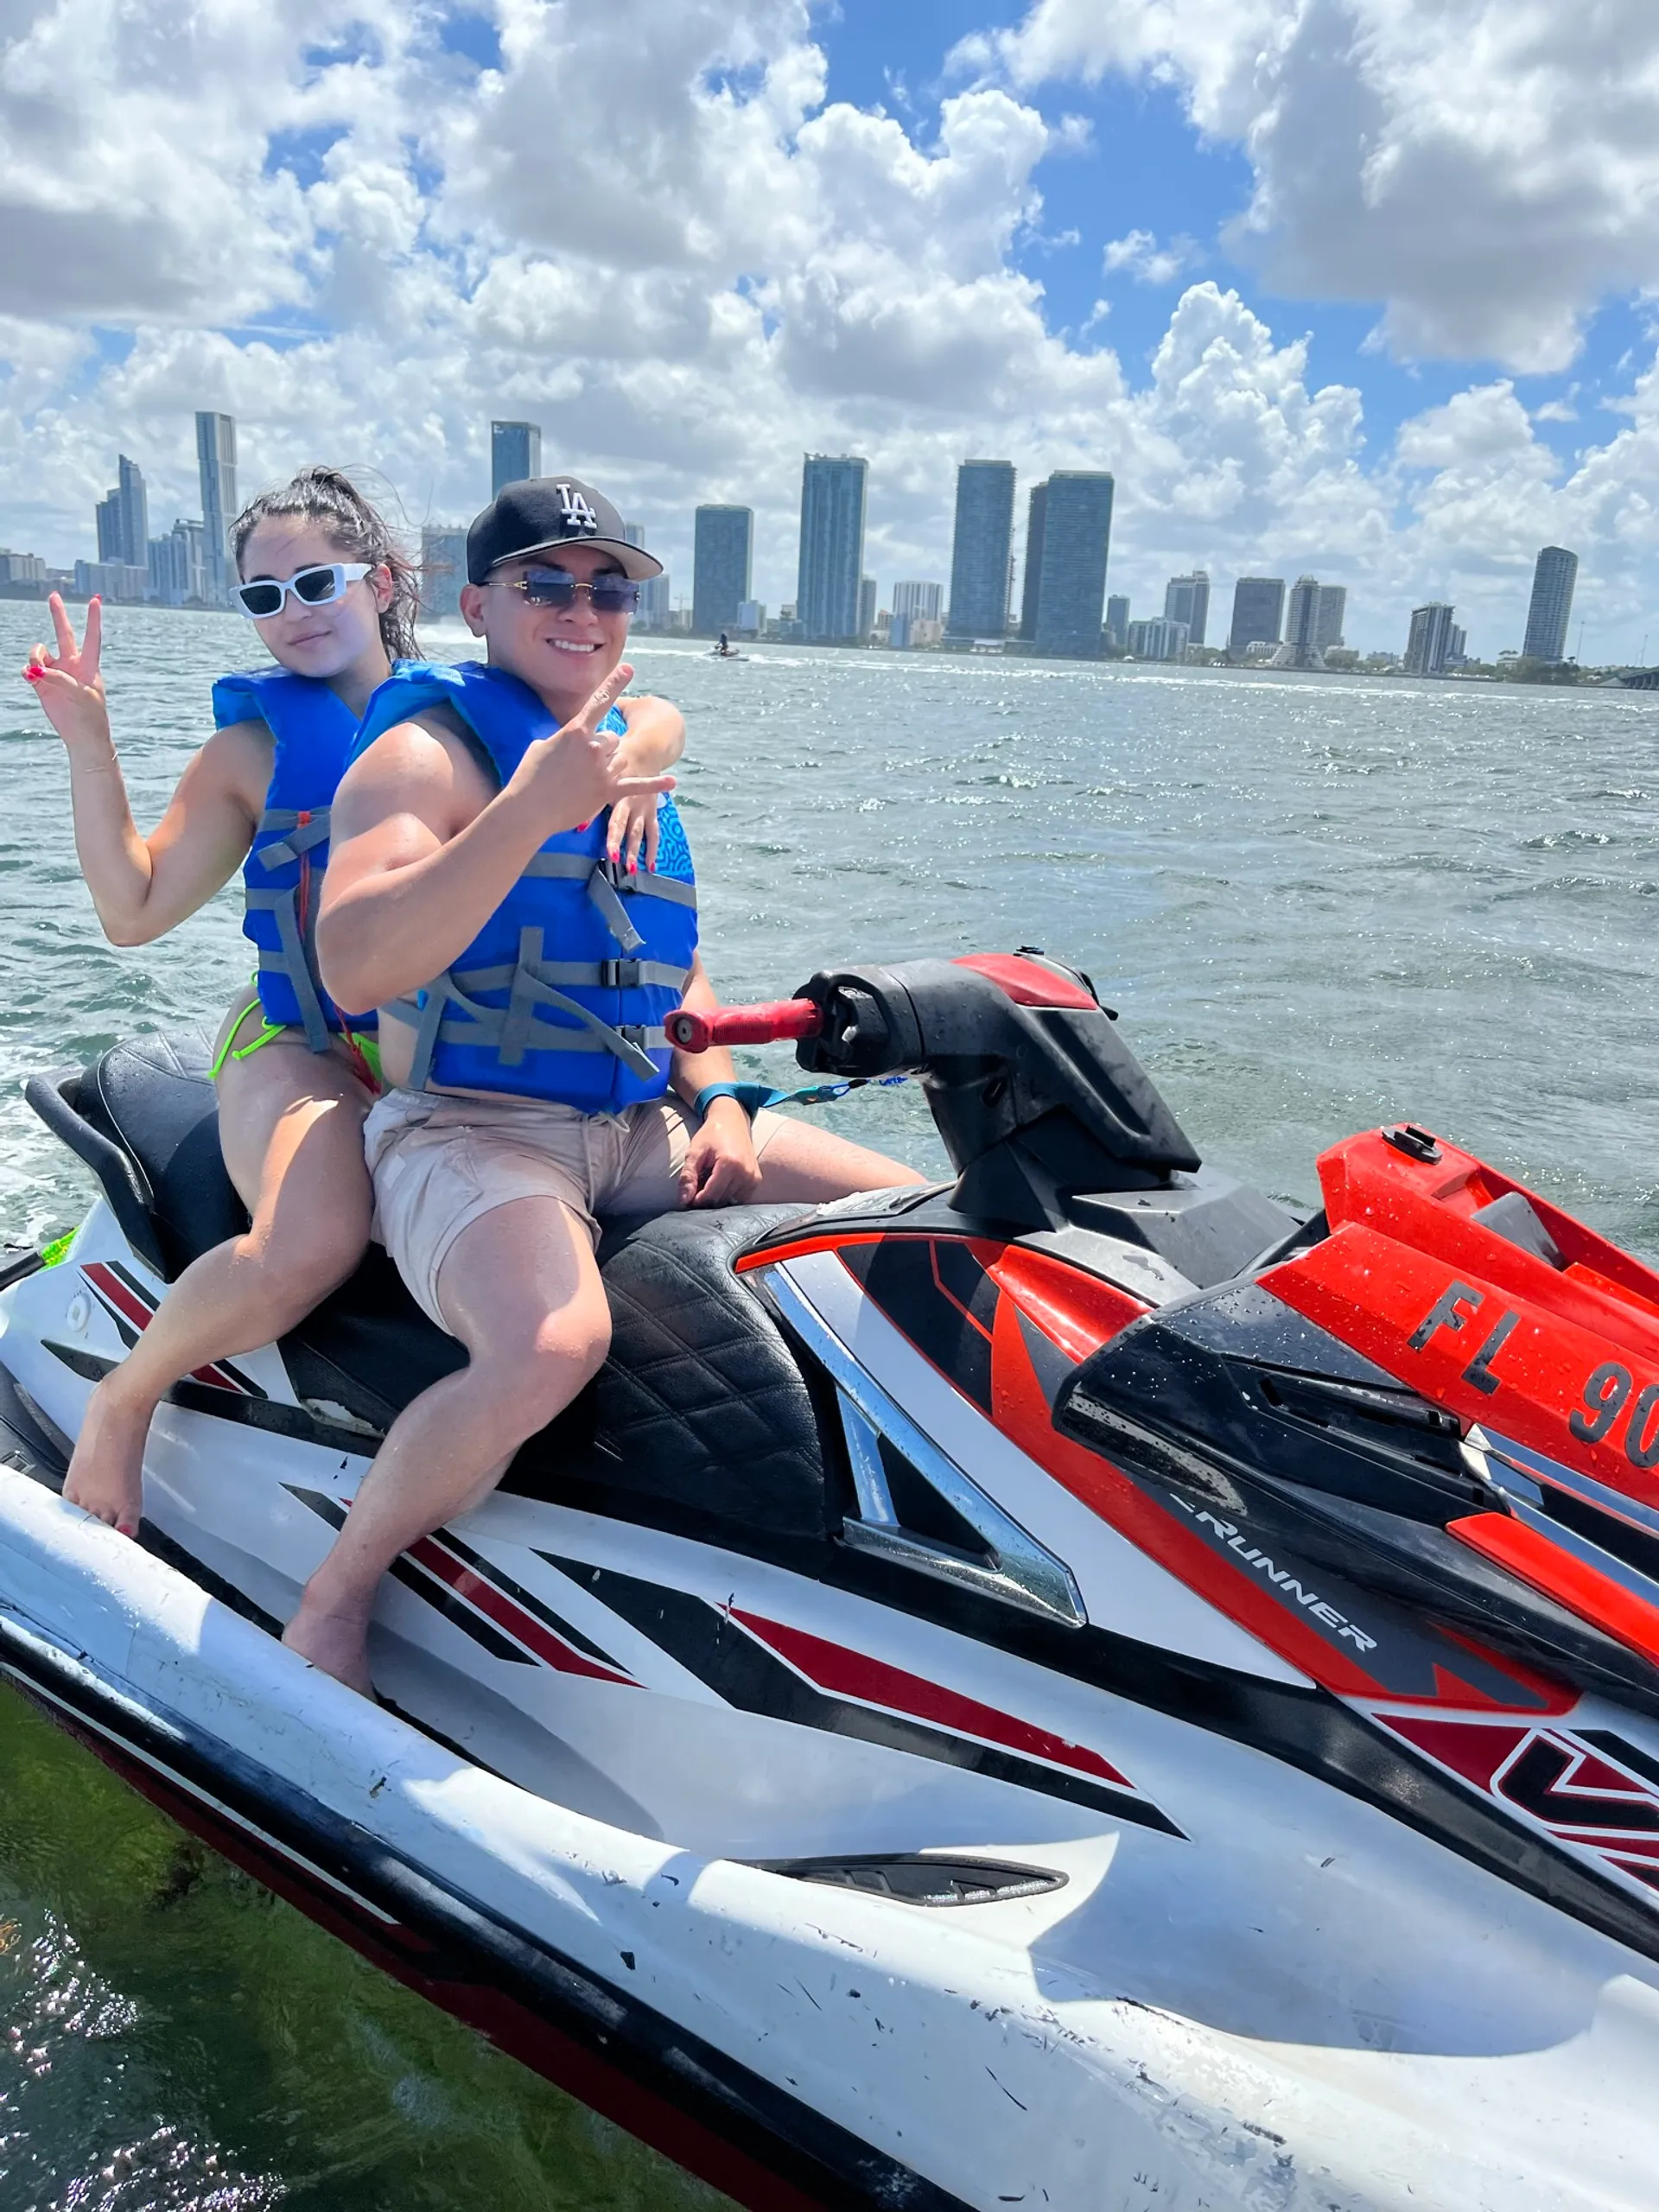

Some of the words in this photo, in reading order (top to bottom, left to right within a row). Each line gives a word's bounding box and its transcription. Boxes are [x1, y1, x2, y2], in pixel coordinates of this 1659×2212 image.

[556, 484, 597, 529] LA
[1407, 1280, 1521, 1395] FL
[1170, 1493, 1377, 1652] RUNNER
